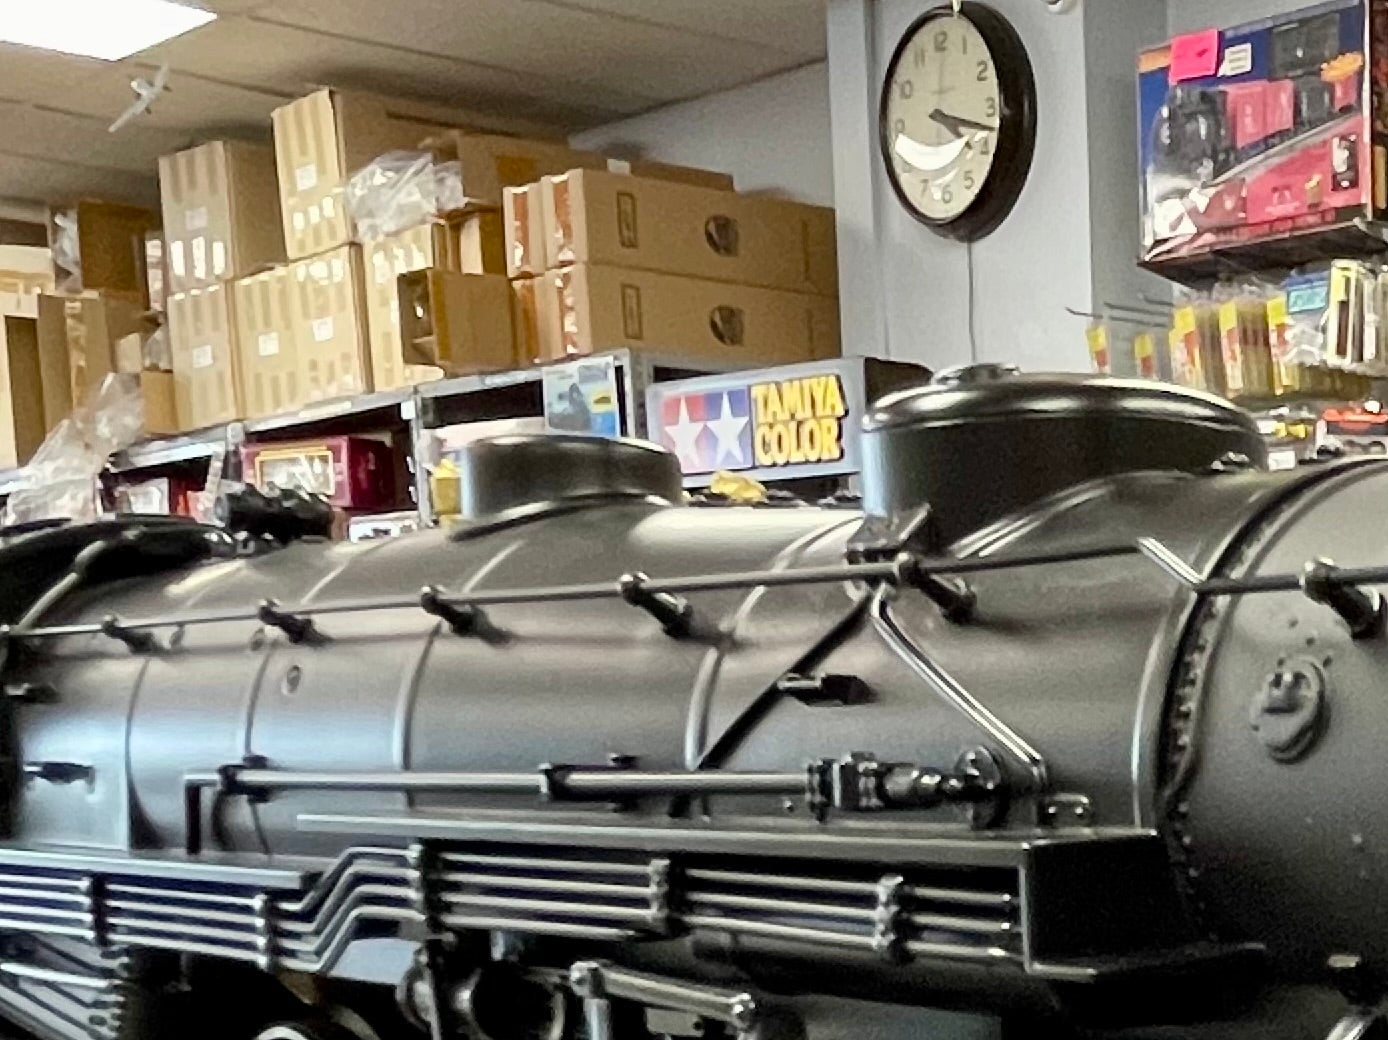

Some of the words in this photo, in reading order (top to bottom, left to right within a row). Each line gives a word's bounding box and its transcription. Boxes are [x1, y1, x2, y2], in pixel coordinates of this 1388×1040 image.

[976, 60, 988, 81] 2
[984, 97, 996, 117] 3
[963, 170, 975, 189] 5
[751, 375, 845, 424] TAMIYA
[754, 418, 843, 466] COLOR
